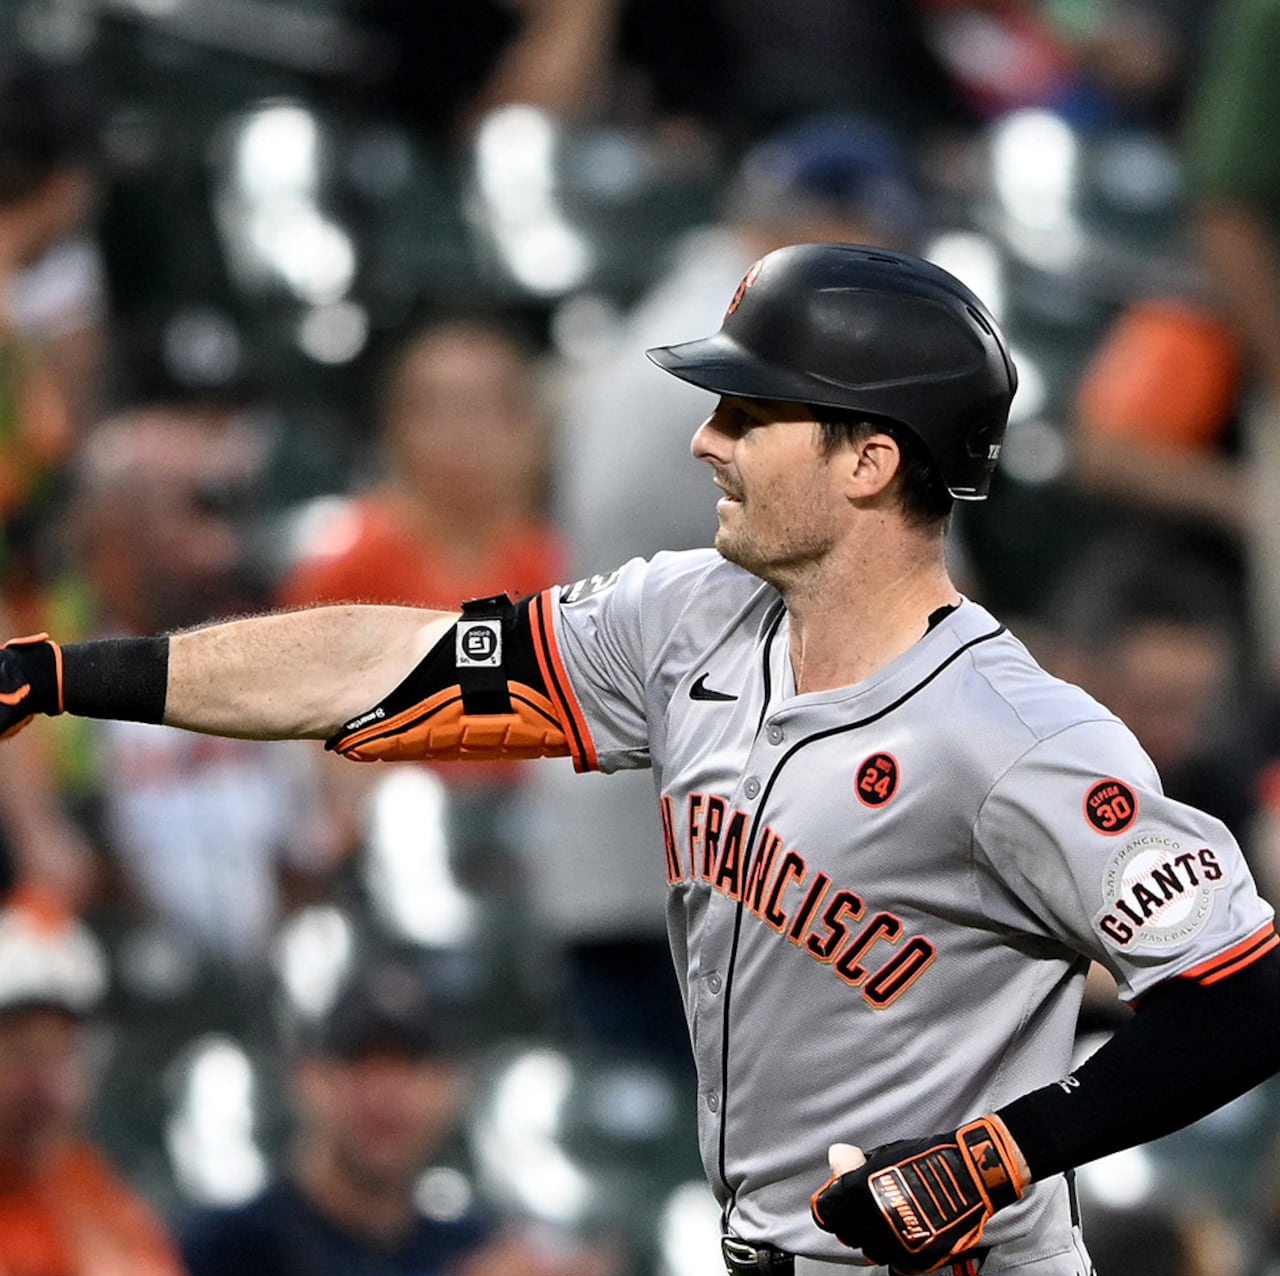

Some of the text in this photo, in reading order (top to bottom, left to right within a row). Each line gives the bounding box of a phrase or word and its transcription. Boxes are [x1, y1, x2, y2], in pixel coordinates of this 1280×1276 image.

[860, 767, 890, 799] 24
[1096, 795, 1131, 828] 30
[1113, 836, 1181, 866] FRANCISCO
[687, 792, 937, 1011] FRANCISCO
[1098, 848, 1223, 945] GIANTS
